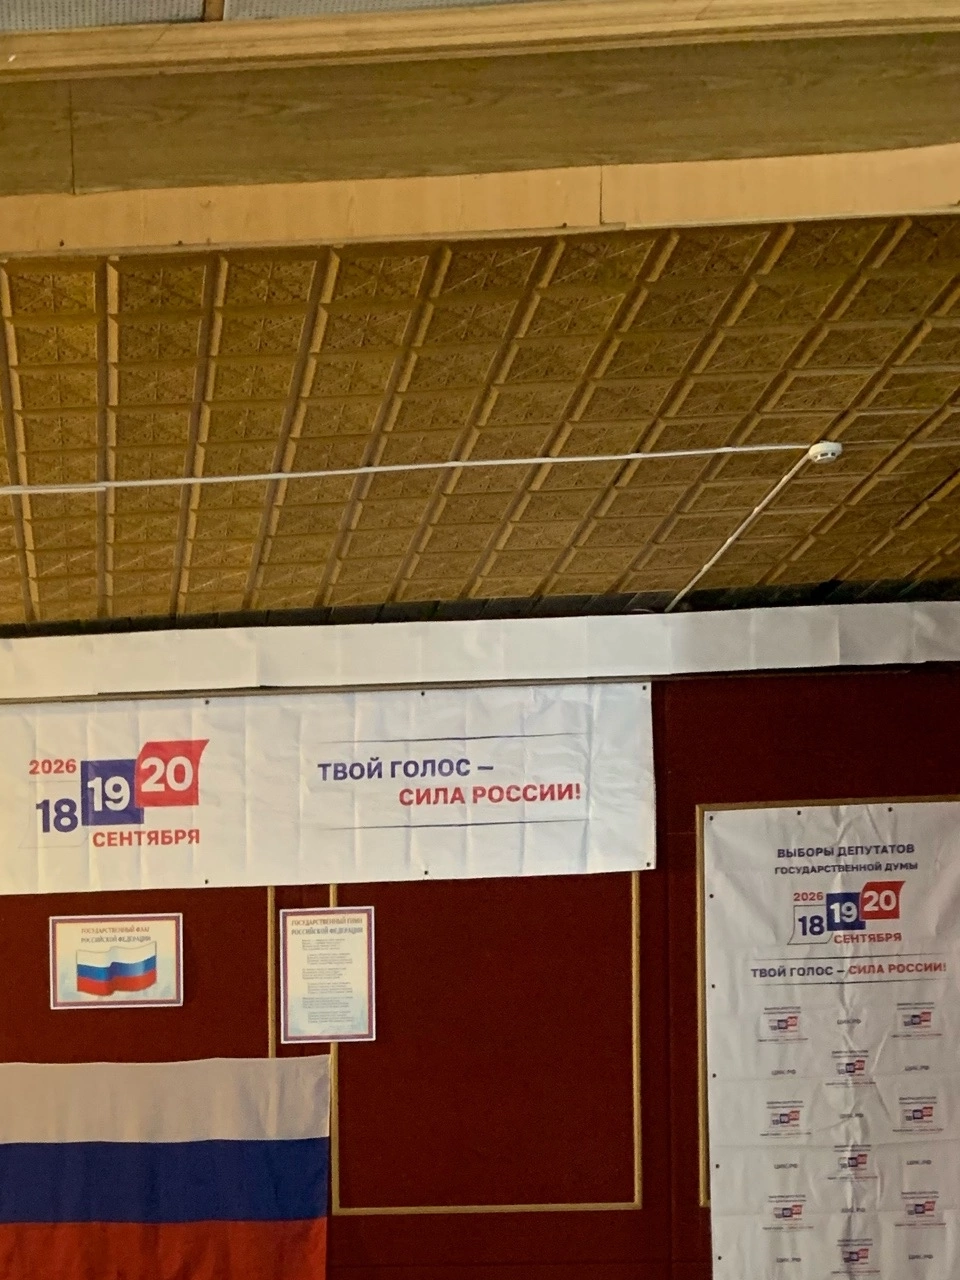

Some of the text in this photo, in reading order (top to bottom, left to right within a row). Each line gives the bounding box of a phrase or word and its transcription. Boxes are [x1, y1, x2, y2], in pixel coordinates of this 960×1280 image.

[29, 759, 77, 775] 2026
[318, 757, 383, 781] ТВОЙ
[390, 758, 471, 778] ГОЛОС
[36, 755, 194, 833] 18 19 20
[399, 783, 581, 806] СИЛА РОССИИ!
[92, 829, 200, 848] СЕНТЯБРЯ
[777, 843, 915, 859] ВЫБОРЫ ДЕПУТАТОВ
[774, 861, 919, 875] ГОСУДАРСТВЕННОЙ ДУМЫ
[793, 891, 824, 902] 2026
[797, 889, 897, 936] 18 19 20
[833, 932, 902, 944] СЕНТЯБРЯ
[750, 964, 787, 978] ТВОЙ
[790, 965, 834, 977] ГОЛОС
[848, 963, 885, 975] СИЛА
[888, 962, 947, 974] РОССИИ!
